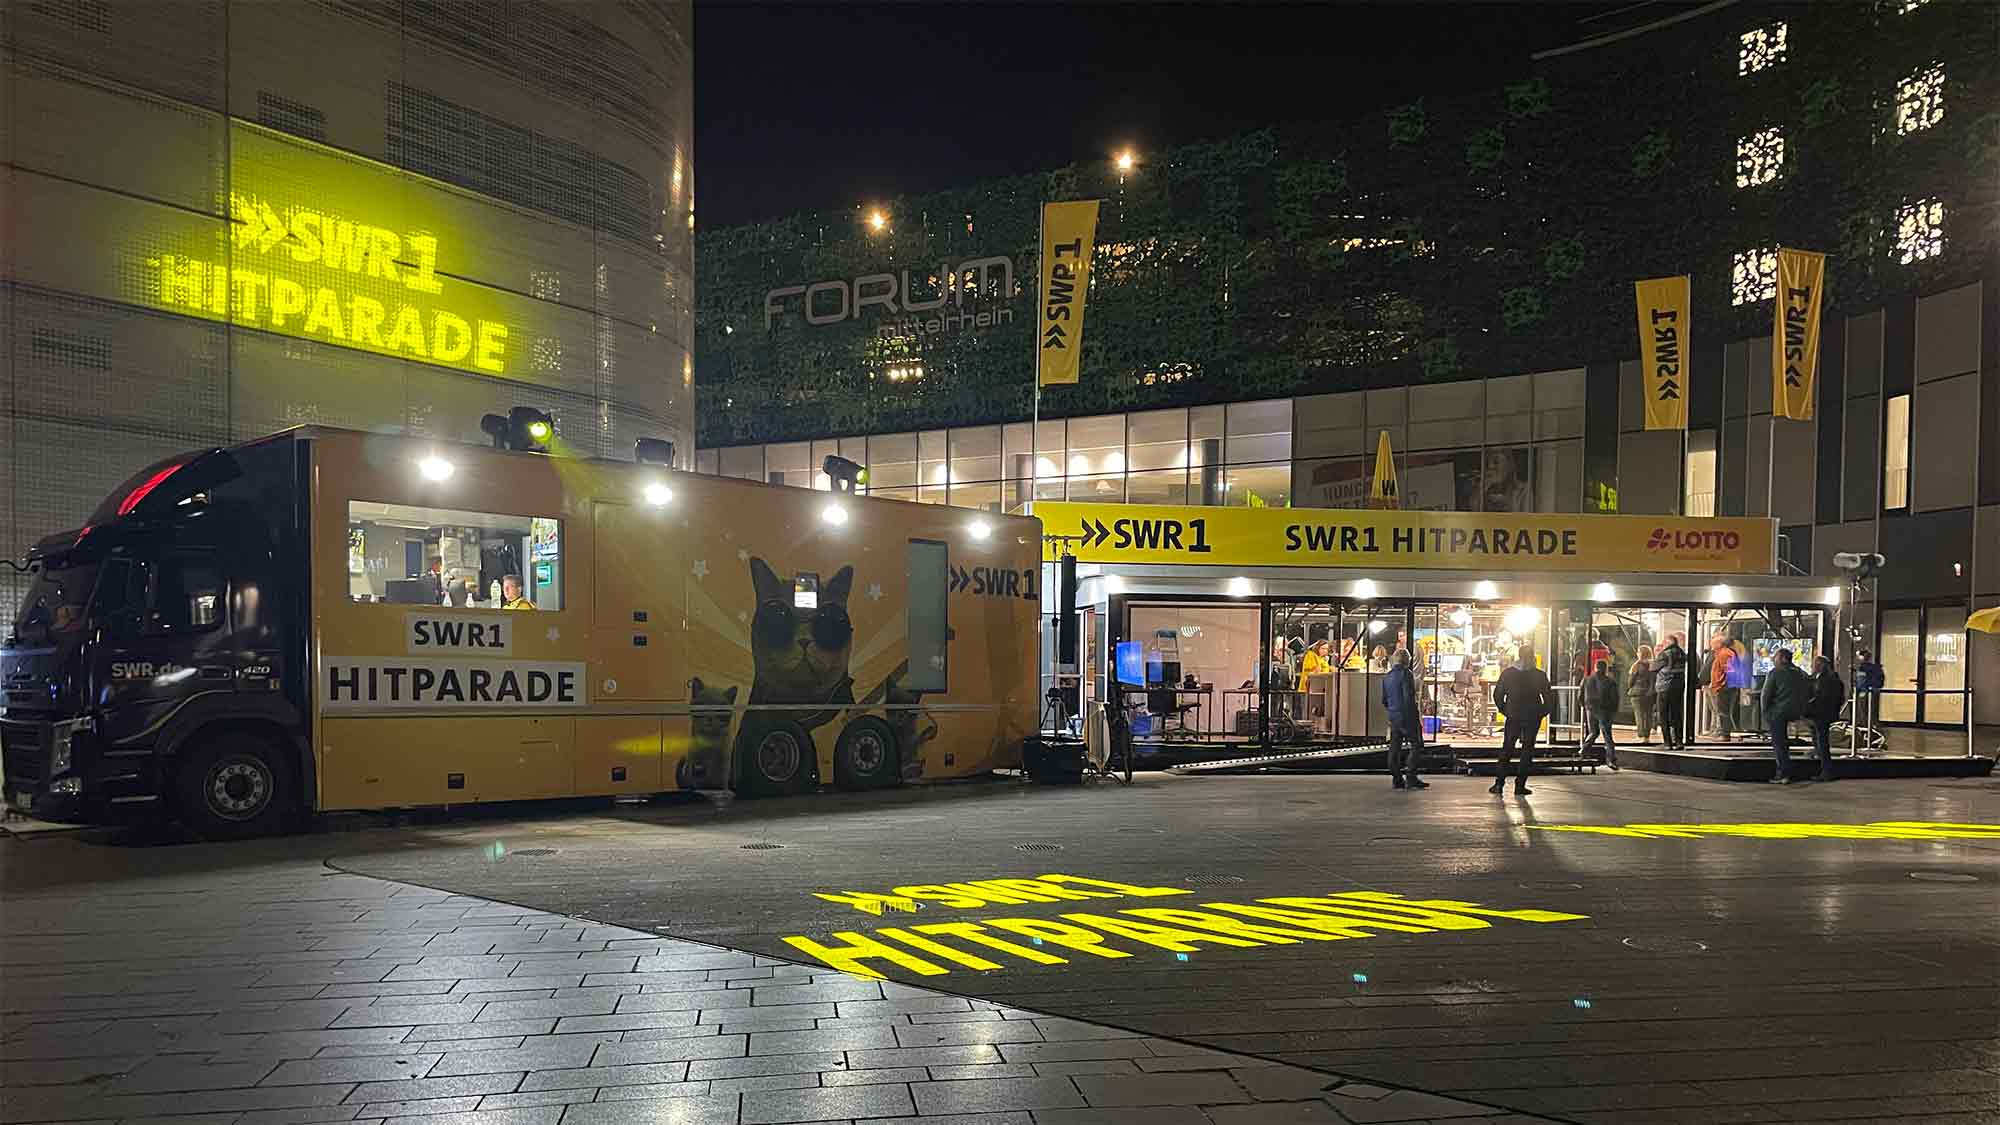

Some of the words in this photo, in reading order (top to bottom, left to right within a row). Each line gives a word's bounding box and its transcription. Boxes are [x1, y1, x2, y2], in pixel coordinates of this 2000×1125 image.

[290, 205, 443, 294] SWR1
[155, 254, 509, 372] HITPARADE
[1784, 286, 1810, 361] SWR1
[1113, 518, 1211, 553] SWR1
[1285, 524, 1380, 553] SWR1
[1392, 527, 1577, 556] HITPARADE
[1674, 530, 1740, 549] LOTTO
[972, 566, 1040, 601] SWR1
[413, 620, 506, 649] SWR1
[243, 666, 271, 676] 420
[329, 666, 576, 703] HITPARADE
